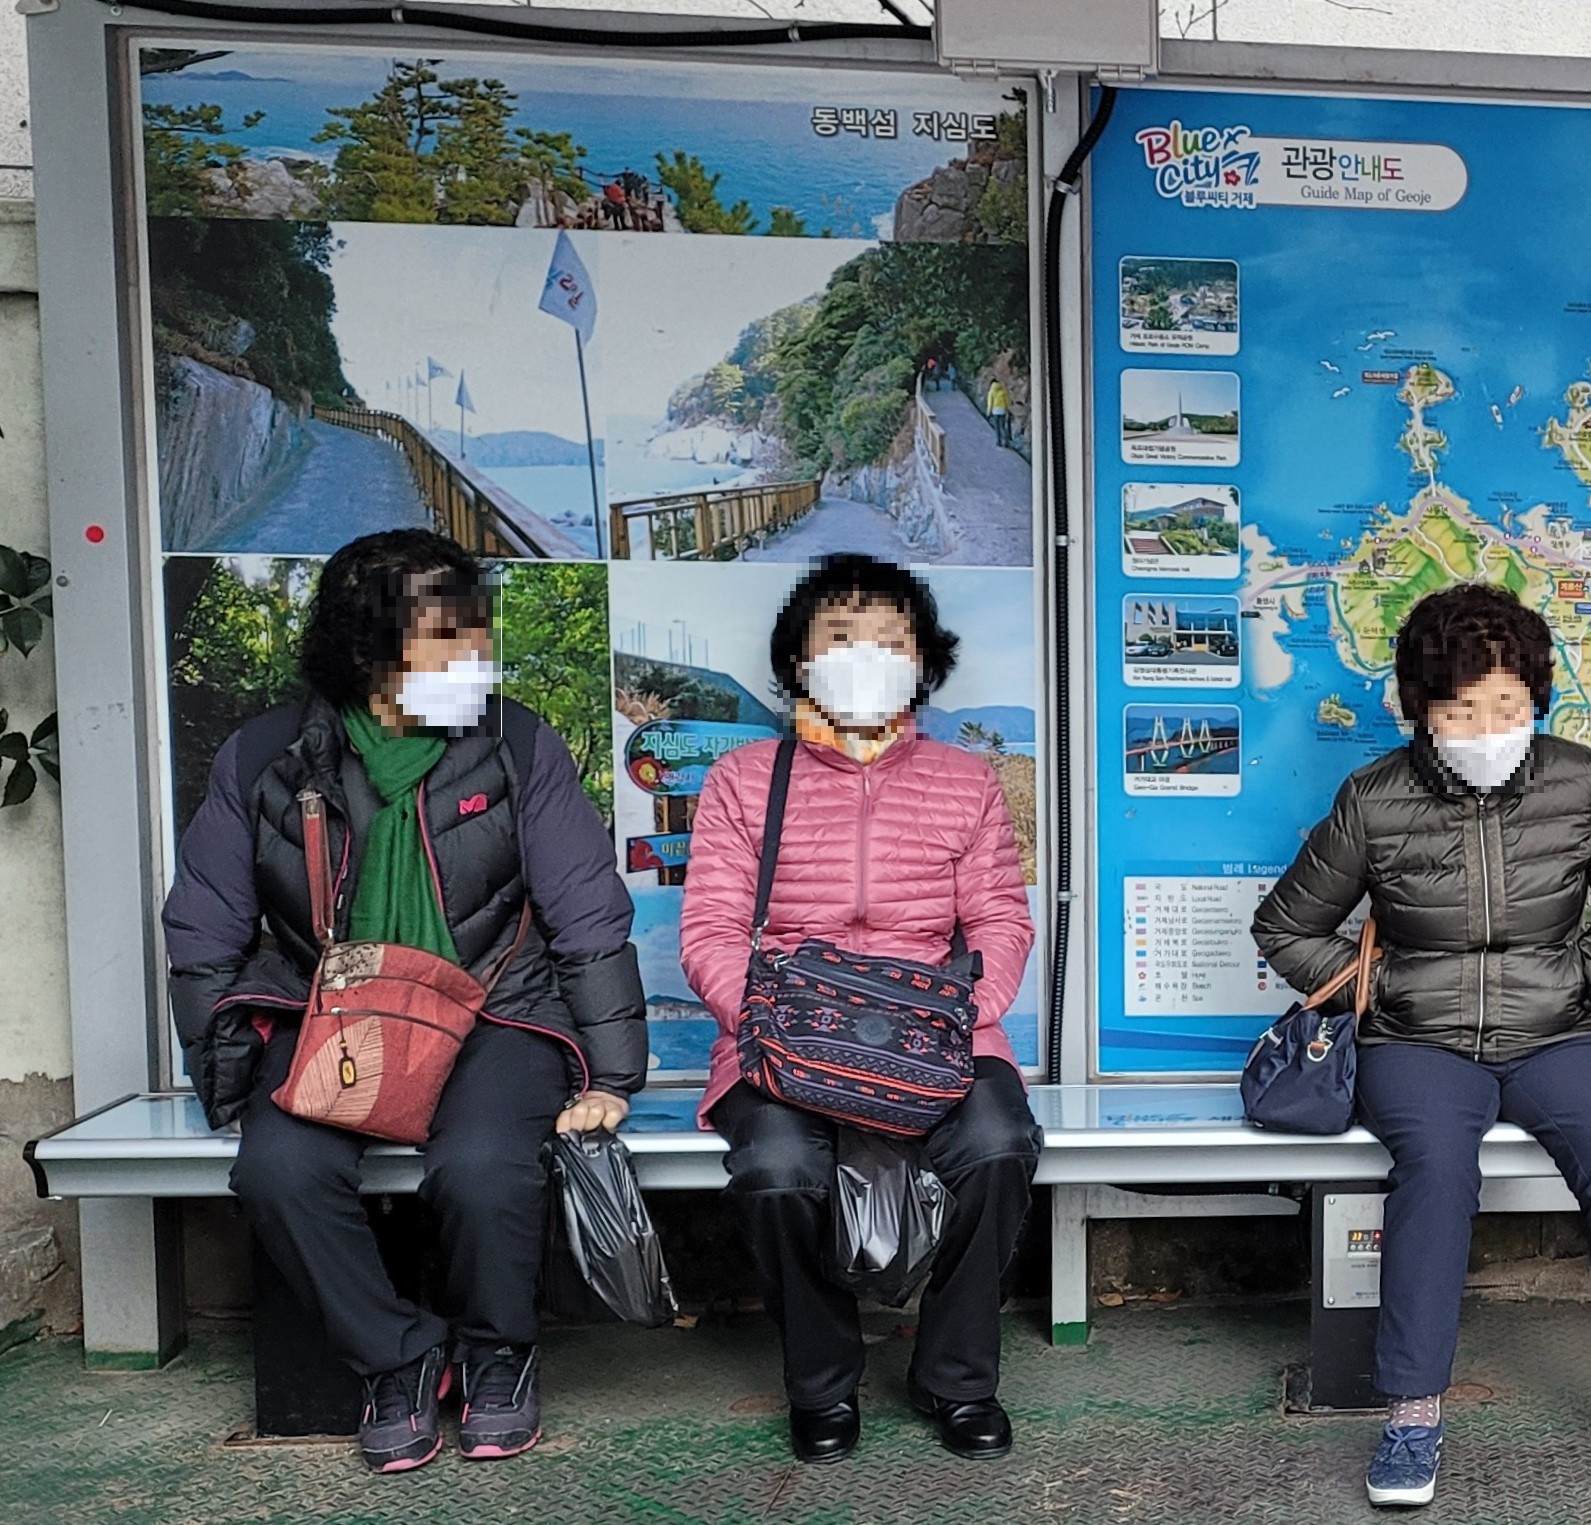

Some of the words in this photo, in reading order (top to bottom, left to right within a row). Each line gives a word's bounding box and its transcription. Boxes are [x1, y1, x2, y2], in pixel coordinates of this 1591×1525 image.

[811, 107, 898, 139] 동백섬
[912, 111, 998, 141] 지심도
[1138, 123, 1221, 165] Blue
[1159, 154, 1221, 195] City
[1281, 145, 1404, 182] 관광안내도
[1184, 190, 1228, 204] 블루씨티
[1231, 192, 1254, 206] 거제
[1301, 184, 1339, 200] Guide
[1344, 187, 1373, 203] Map
[1377, 189, 1391, 201] of
[1395, 190, 1432, 206] Geoje
[1222, 863, 1244, 875] 범례
[1247, 863, 1288, 876] Legend
